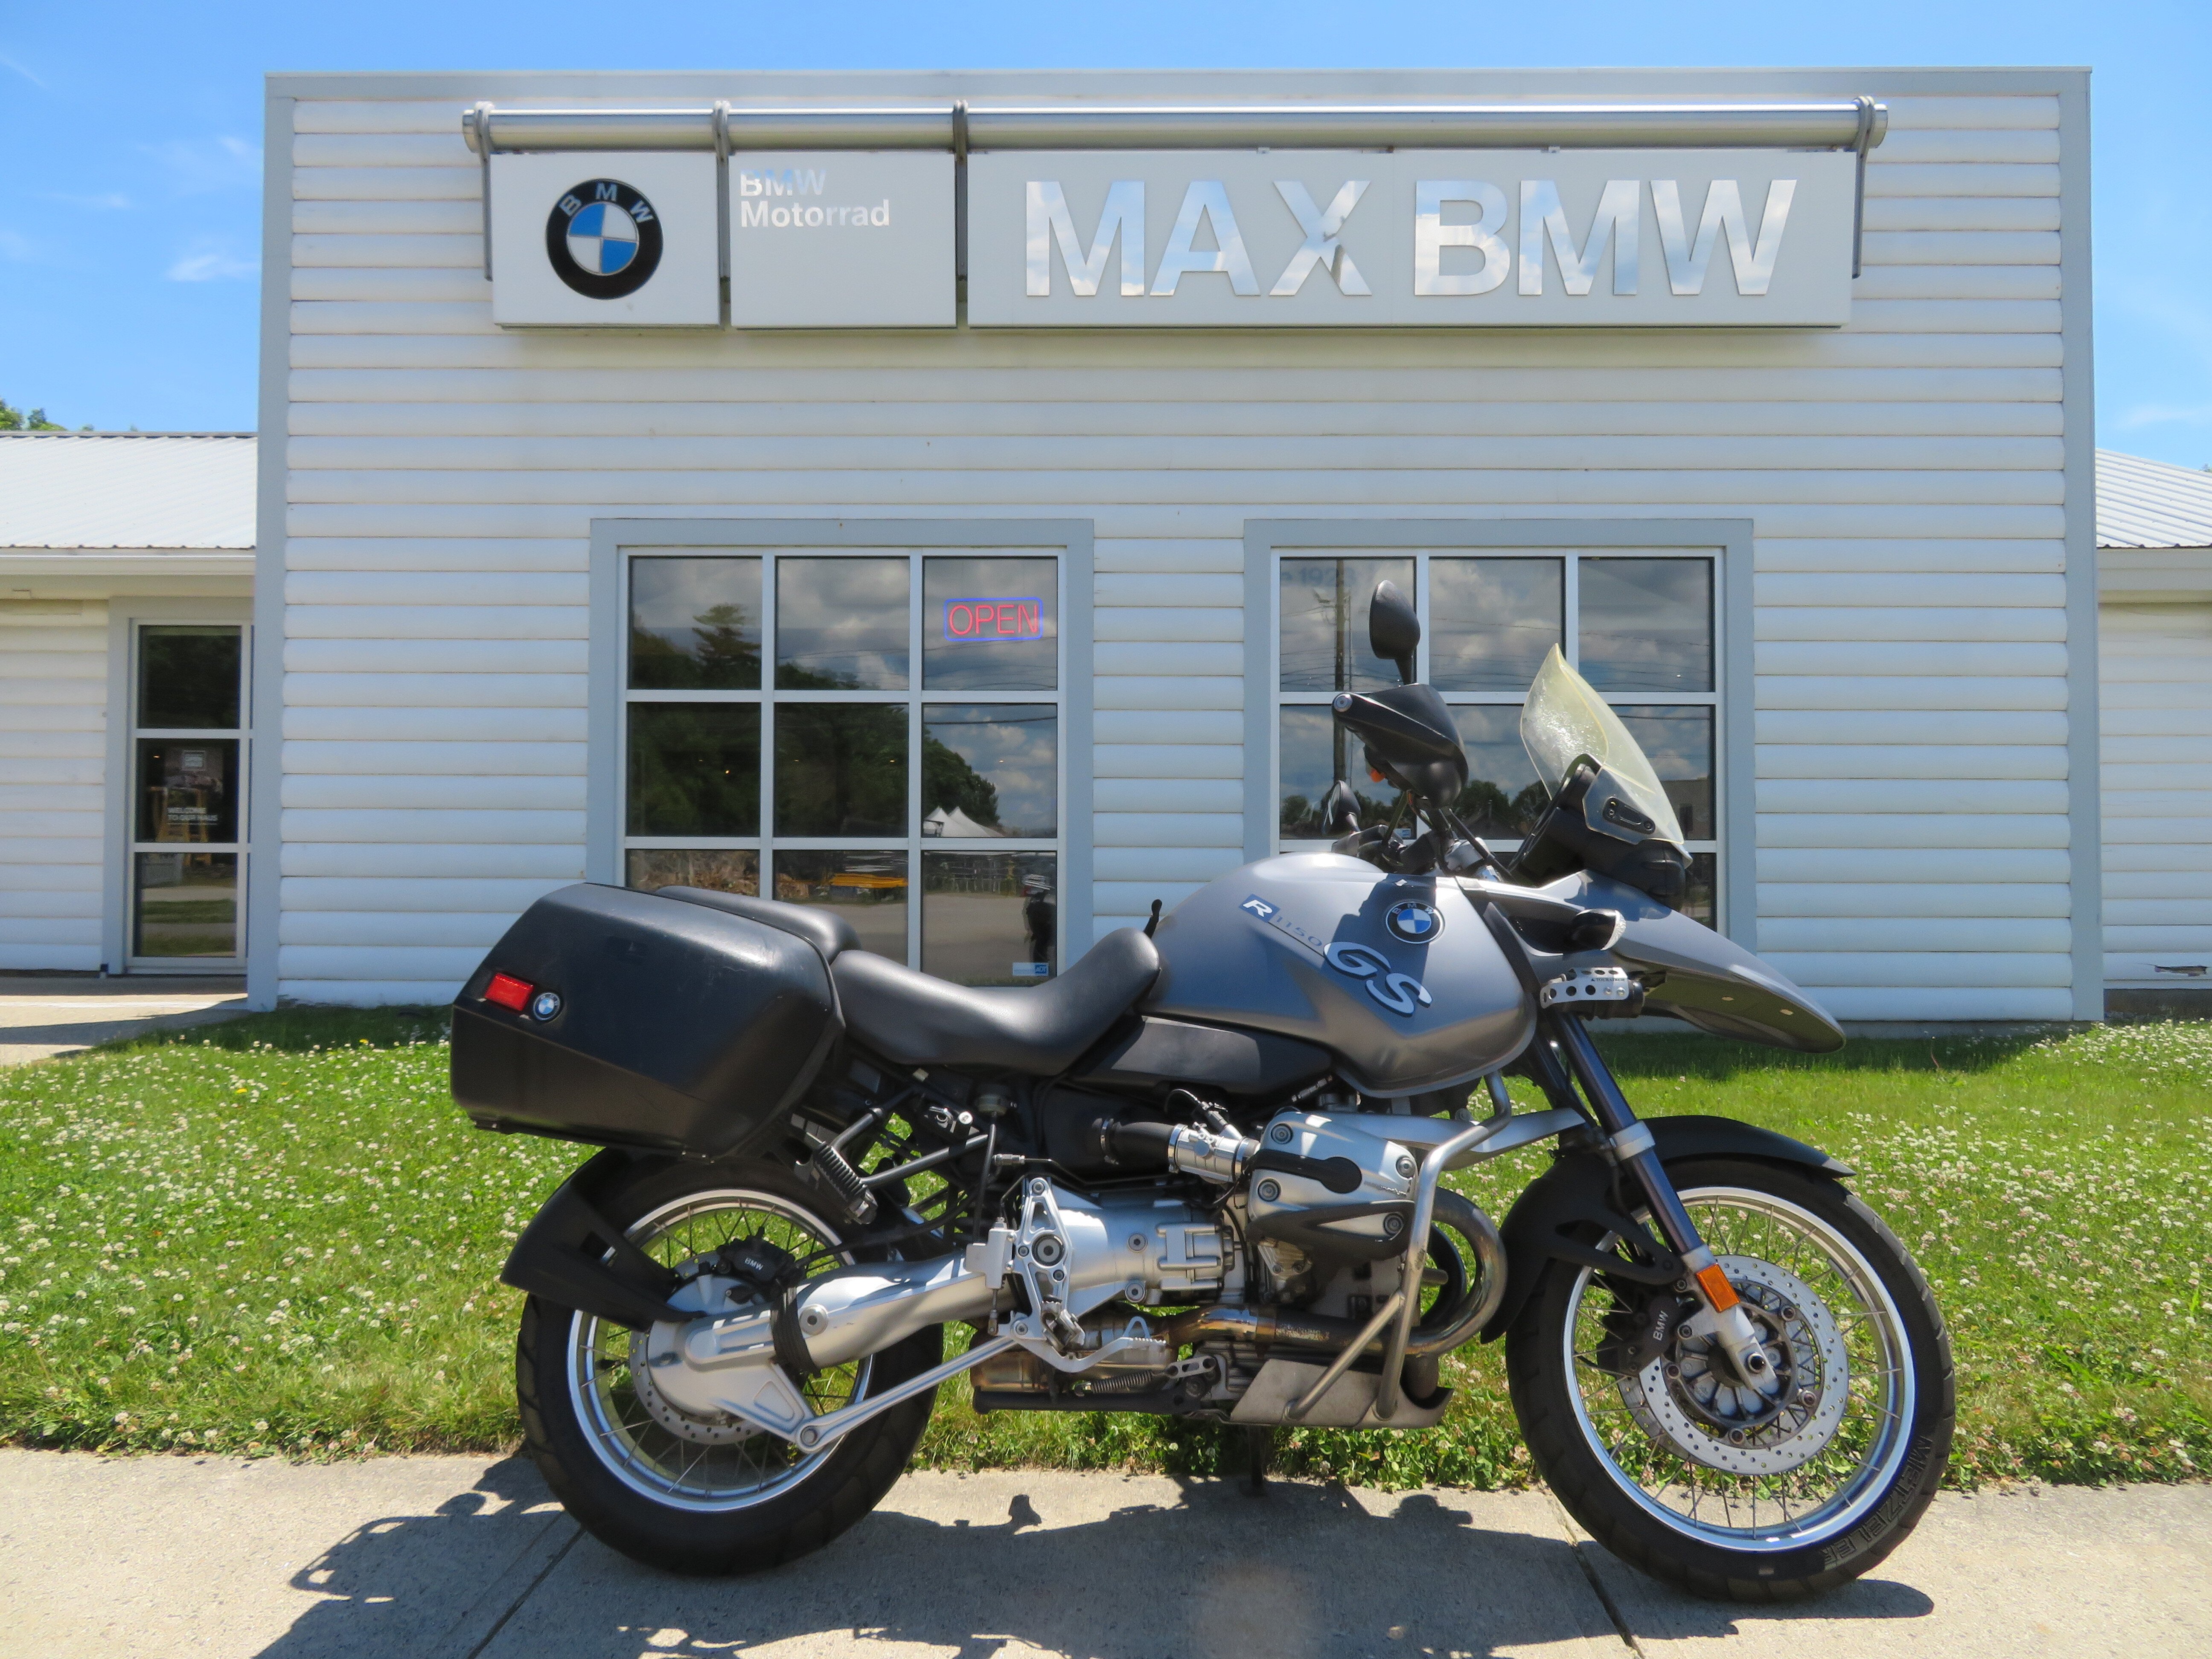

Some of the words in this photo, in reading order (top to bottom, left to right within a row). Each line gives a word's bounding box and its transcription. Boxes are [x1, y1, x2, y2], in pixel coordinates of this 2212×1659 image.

[740, 169, 826, 196] BMW
[558, 182, 655, 223] BMW
[740, 198, 890, 228] Motorrad
[1026, 180, 1372, 297] MAX
[1415, 180, 1797, 296] BMW
[949, 604, 1039, 635] OPEN
[1391, 902, 1435, 915] BMW
[1242, 899, 1273, 917] R
[1276, 916, 1323, 947] 1150
[1324, 941, 1433, 1016] GS
[745, 1257, 764, 1270] BMW
[1653, 1310, 1669, 1341] BMW
